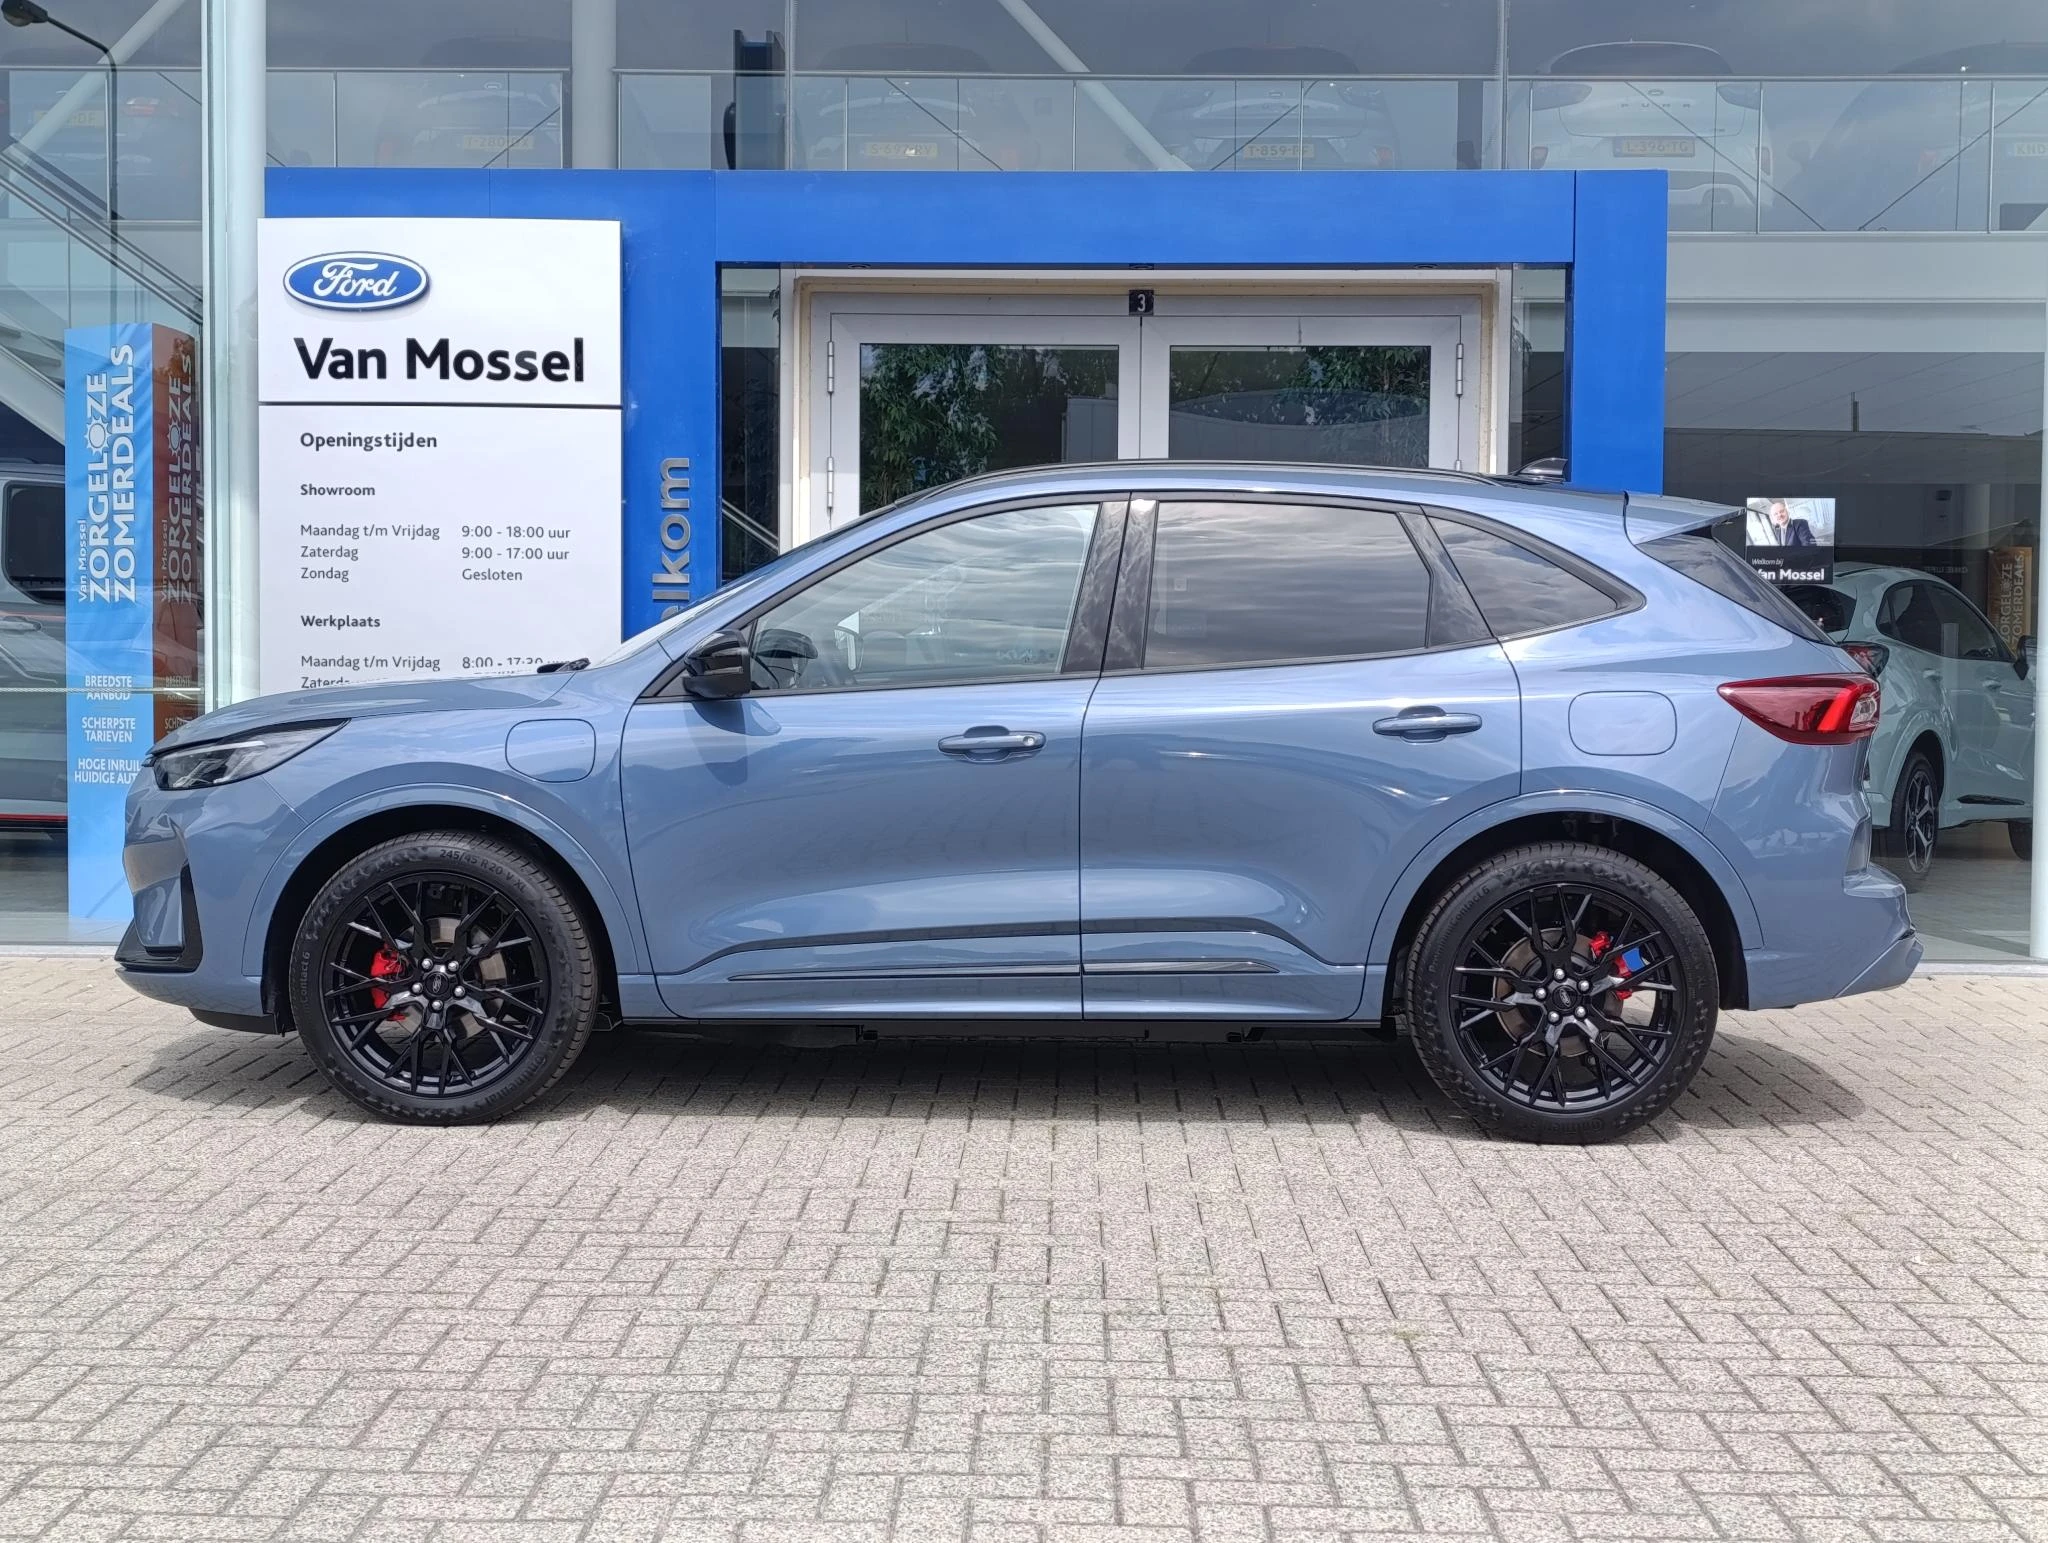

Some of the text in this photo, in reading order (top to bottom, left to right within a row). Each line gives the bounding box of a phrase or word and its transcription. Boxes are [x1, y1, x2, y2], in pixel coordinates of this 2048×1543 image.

[313, 260, 400, 298] Ford
[1137, 293, 1146, 312] 3
[293, 337, 585, 382] Van Mossel
[300, 432, 438, 452] Openingstijden
[111, 344, 136, 603] ZOMERDEALS
[300, 483, 376, 496] Showroom
[300, 524, 360, 540] Maandag
[363, 524, 388, 537] t/m
[391, 524, 440, 541] Vrijdag
[461, 525, 493, 538] 9:00
[506, 526, 544, 538] 18:00
[548, 529, 571, 539] uur
[77, 519, 88, 602] Van Mossel
[300, 545, 359, 561] Zaterdag
[461, 547, 493, 559] 9:00
[506, 547, 543, 560] 17:00
[547, 551, 570, 560] uur
[300, 567, 523, 583] Zondag Gesloten
[1780, 567, 1825, 581] Mossel
[300, 615, 381, 631] Werkplaats
[301, 655, 360, 671] Maandag
[364, 655, 388, 668] t/m
[392, 656, 441, 672] Vrijdag
[462, 656, 494, 669] 8:00
[85, 676, 132, 688] BREEDSTE
[81, 717, 136, 730] SCHERPSTE
[84, 730, 132, 743] TARIEVEN
[78, 758, 105, 770] HOGE
[74, 771, 138, 785] HUIDIGE AUT
